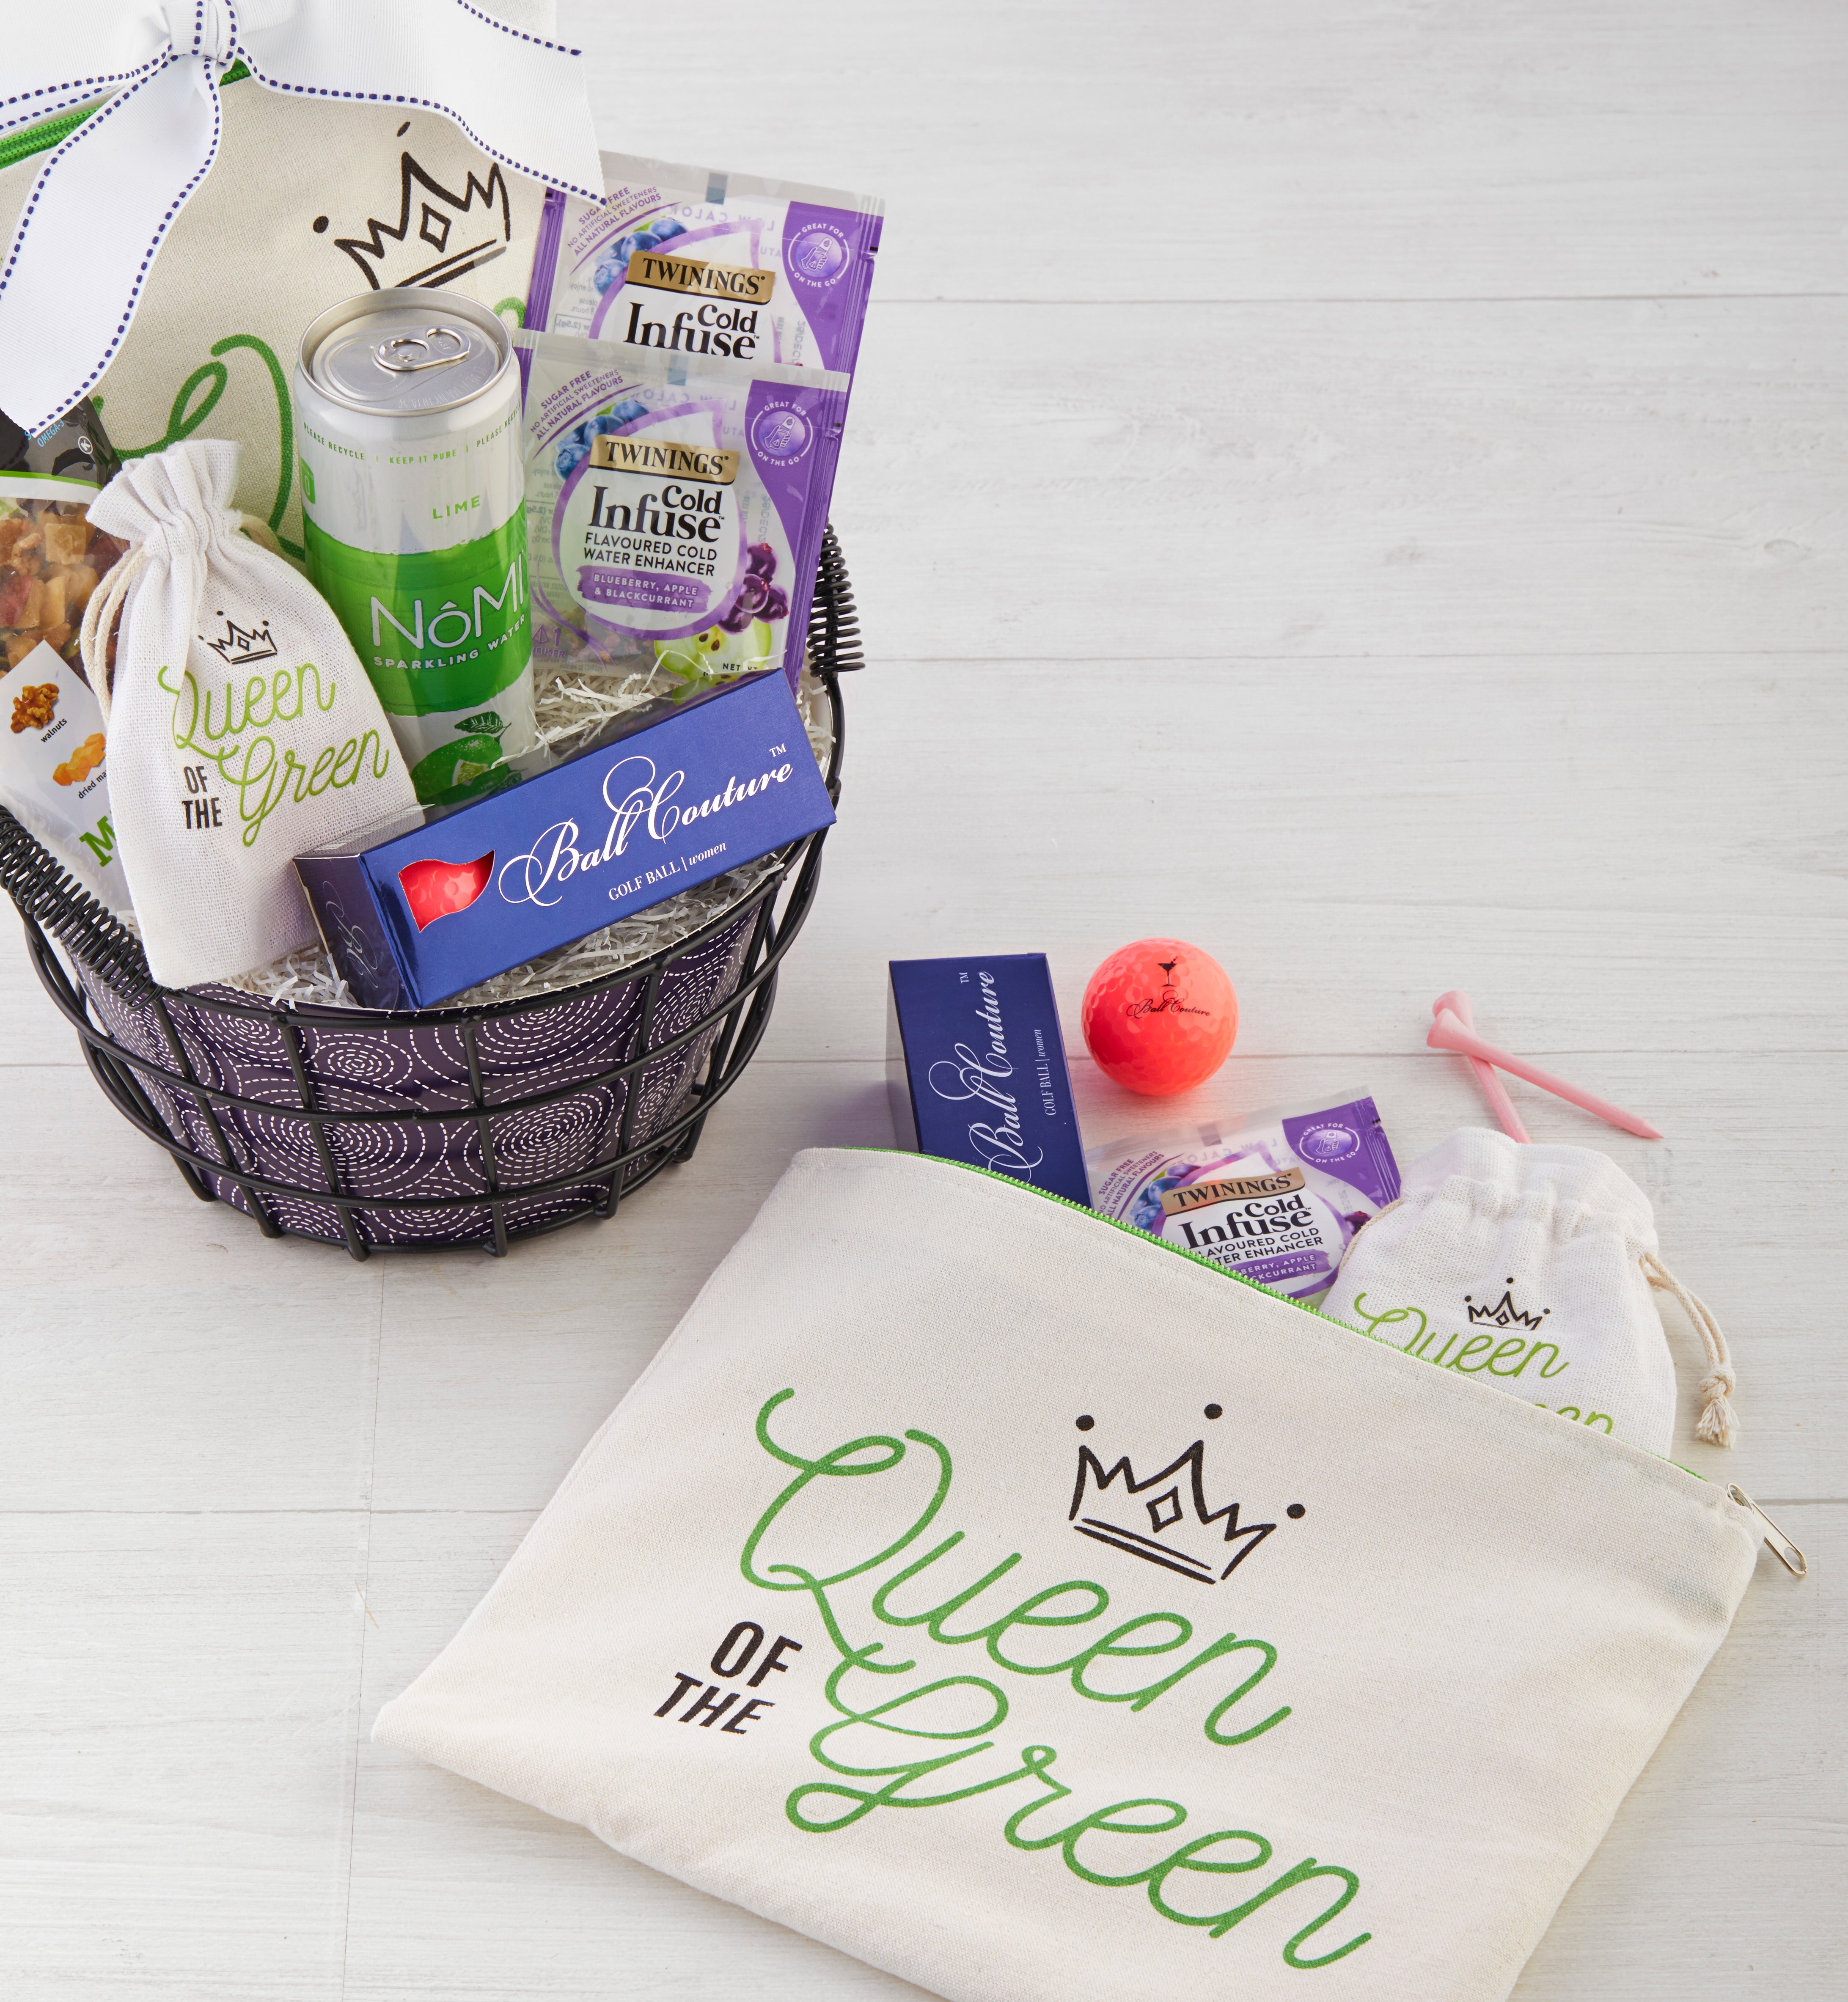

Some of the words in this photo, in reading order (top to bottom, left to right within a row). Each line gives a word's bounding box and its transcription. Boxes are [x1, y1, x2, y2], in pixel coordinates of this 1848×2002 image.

[608, 187, 630, 203] FREE
[568, 236, 579, 248] NO
[578, 210, 612, 238] ARTIFICIAL
[612, 186, 657, 212] SWEETENERS
[574, 242, 587, 256] ALL
[586, 213, 620, 244] NATURAL
[620, 193, 662, 217] FLAVOURS
[802, 223, 827, 233] GREAT
[829, 225, 844, 239] FOR
[642, 257, 760, 295] TWININGS
[794, 272, 806, 286] ON
[807, 279, 822, 288] THE
[825, 278, 836, 288] GO
[623, 302, 756, 360] Infuse
[697, 303, 759, 334] Cold
[530, 422, 541, 433] NO
[539, 394, 575, 423] ARTIFICIAL
[574, 369, 619, 396] SWEETENERS
[541, 385, 568, 409] SUGAR
[569, 371, 593, 388] FREE
[536, 426, 549, 440] ALL
[548, 398, 582, 428] NATURAL
[581, 375, 624, 402] FLAVOURS
[764, 402, 790, 411] GREAT
[791, 404, 807, 416] FOR
[476, 425, 503, 447] PLEASE
[504, 400, 521, 428] RECYCLE
[304, 422, 325, 446] PLEASE
[328, 441, 365, 460] RECYCLE
[389, 456, 415, 465] KEEP
[419, 455, 428, 463] IT
[433, 449, 457, 461] PURE
[606, 441, 724, 476] TWININGS
[757, 451, 768, 462] ON
[788, 456, 800, 465] GO
[432, 495, 481, 520] LIME
[587, 485, 721, 543] Infuse
[661, 485, 722, 515] Cold
[583, 547, 630, 565] WATER
[634, 555, 715, 577] ENHANCER
[585, 532, 672, 555] FLAVOURED
[676, 544, 718, 561] COLD
[593, 573, 660, 591] BLUEBERRY,
[663, 584, 698, 596] APPLE
[594, 587, 602, 596] &
[605, 588, 694, 608] BLACKCURRANT
[373, 649, 479, 670] SPARKLING
[487, 613, 525, 651] WATER
[722, 662, 741, 671] NET
[157, 663, 336, 760] Queen
[40, 717, 68, 743] walnuts
[77, 781, 97, 800] dried
[183, 766, 208, 794] OF
[218, 729, 390, 847] Green
[182, 797, 223, 829] THE
[498, 767, 646, 906] Ball
[645, 762, 793, 845] Couture
[608, 876, 644, 901] GOLF
[646, 861, 681, 884] BALL
[689, 842, 727, 866] women
[1126, 995, 1171, 1019] Ball
[1169, 998, 1210, 1016] Couture
[955, 971, 1018, 1078] Couture
[1033, 1029, 1045, 1057] women
[1037, 1063, 1051, 1088] BALL
[1040, 1089, 1057, 1116] GOLF
[961, 1067, 1043, 1183] Ball
[1303, 1124, 1324, 1136] GREAT
[1098, 1172, 1119, 1195] SUGAR
[1116, 1158, 1134, 1172] FREE
[1105, 1176, 1126, 1204] ARTIFICIAL
[1123, 1150, 1158, 1175] SWEETENERS
[1132, 1153, 1165, 1177] FLAVOURS
[1111, 1177, 1136, 1205] NATURAL
[1173, 1174, 1288, 1207] TWININGS
[1244, 1194, 1305, 1218] Cold
[1106, 1206, 1117, 1217] ALL
[1177, 1208, 1314, 1250] Infuse
[1198, 1237, 1275, 1258] AVOURED
[1280, 1227, 1320, 1244] COLD
[1213, 1252, 1241, 1265] TER
[1245, 1237, 1324, 1259] ENHANCER
[1239, 1263, 1279, 1275] BERRY,
[1283, 1254, 1316, 1266] APPLE
[1251, 1264, 1317, 1281] CKCURRANT
[1354, 1292, 1570, 1380] Queen
[740, 1388, 1292, 1747] Queen
[710, 1620, 803, 1688] OF
[653, 1671, 775, 1735] THE
[785, 1642, 1372, 1970] Green
